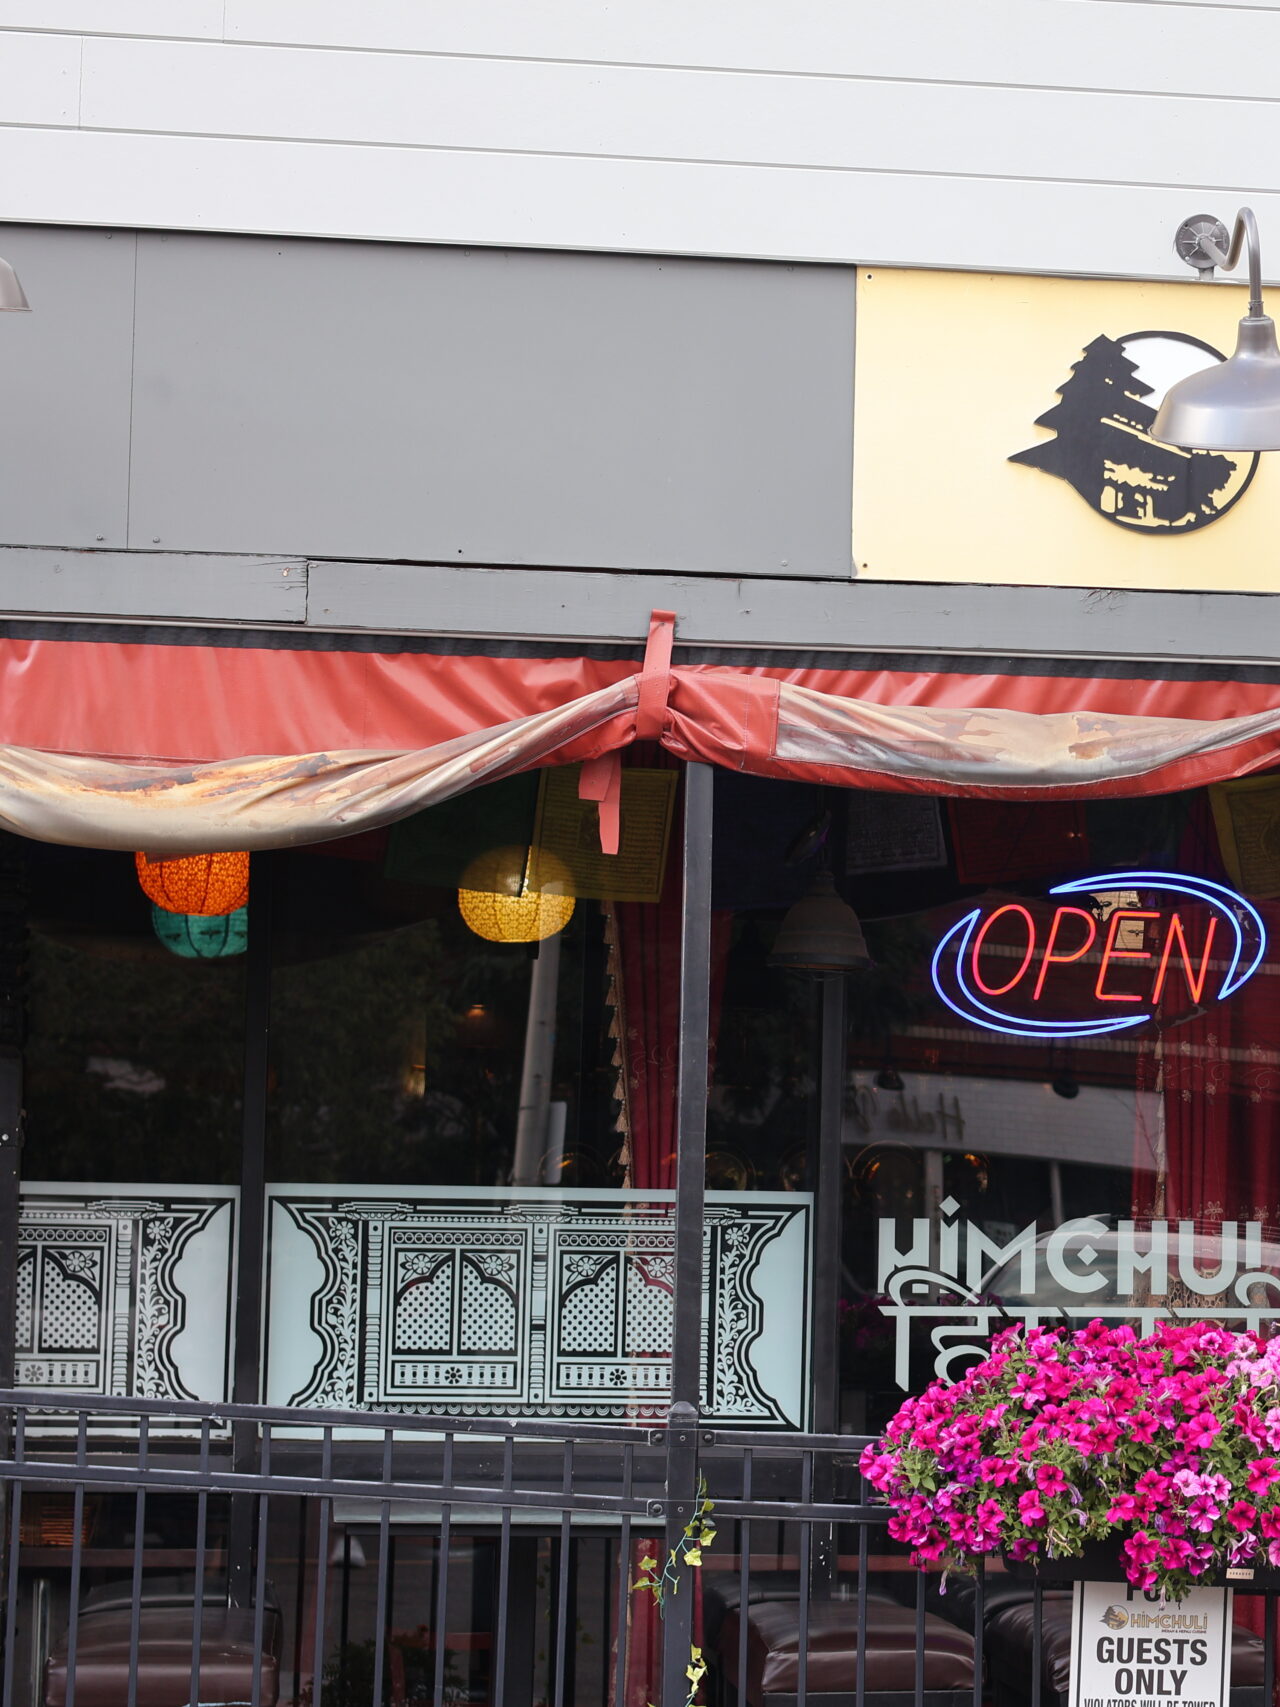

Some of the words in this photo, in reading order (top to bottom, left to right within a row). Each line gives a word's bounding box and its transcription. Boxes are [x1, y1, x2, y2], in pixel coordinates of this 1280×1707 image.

[972, 904, 1217, 1004] OPEN
[1096, 1636, 1208, 1666] GUESTS
[1114, 1667, 1188, 1696] ONLY
